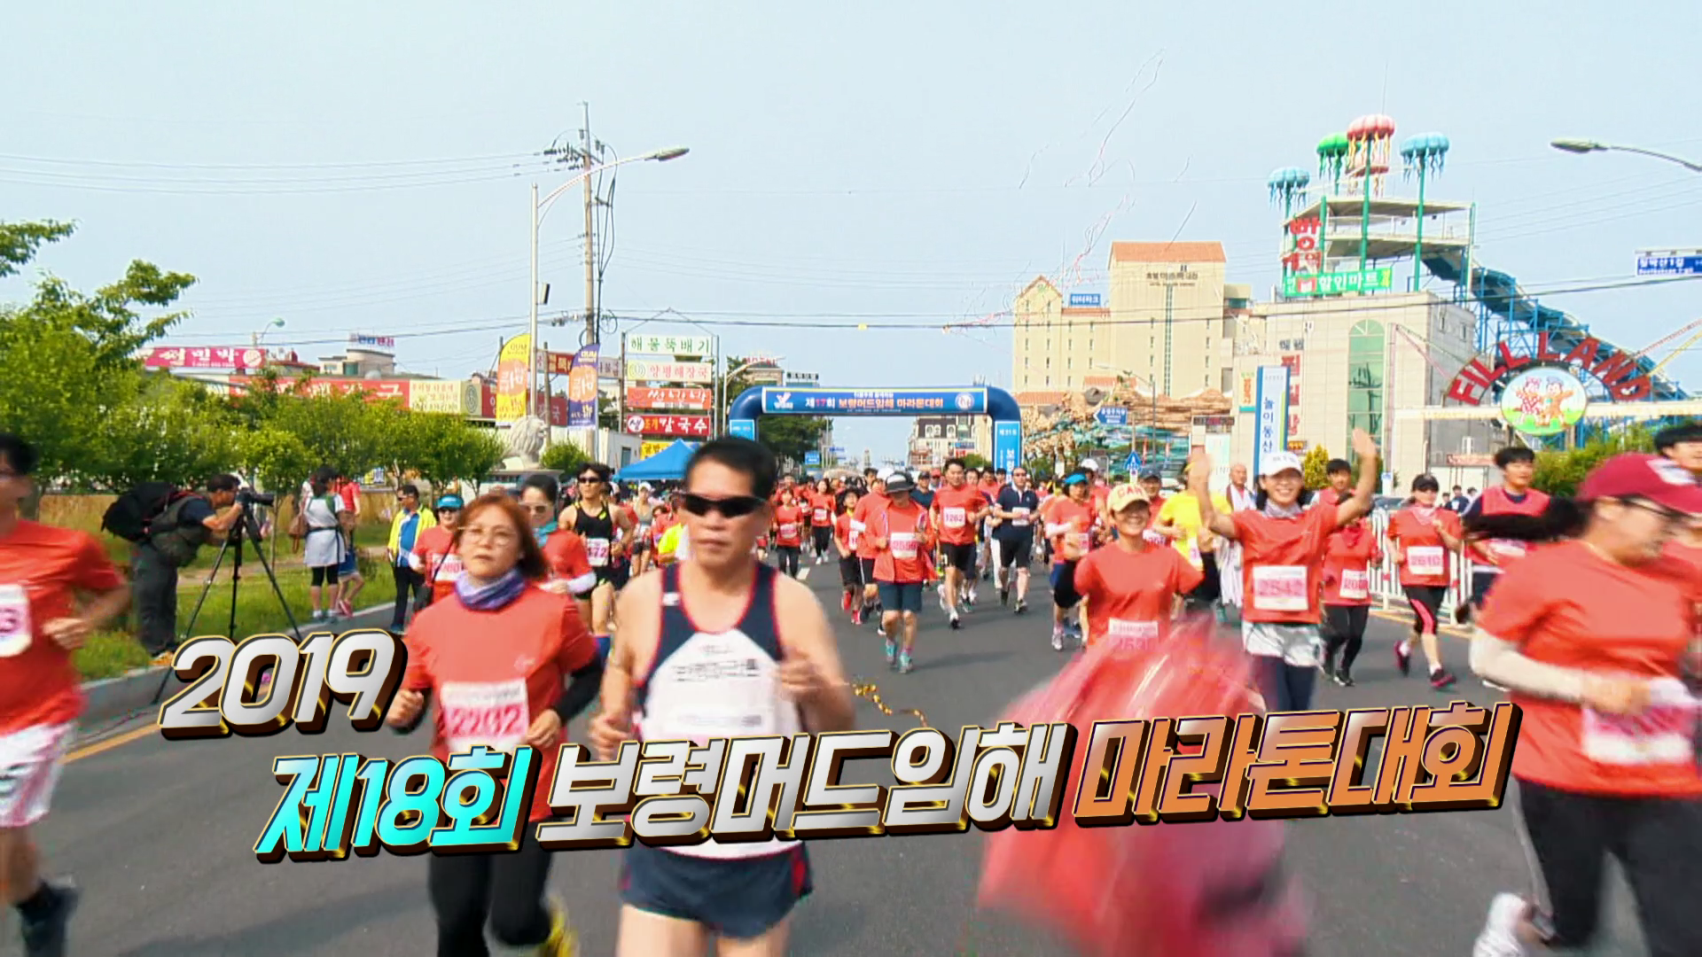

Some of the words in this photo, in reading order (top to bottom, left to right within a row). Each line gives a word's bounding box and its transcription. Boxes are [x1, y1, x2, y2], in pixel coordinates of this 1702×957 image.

[631, 336, 709, 353] 해물뚝배기
[649, 364, 708, 378] 양평해장국
[1447, 341, 1531, 406] FILL
[1538, 331, 1654, 401] LAND
[1262, 397, 1275, 453] 놀이동산
